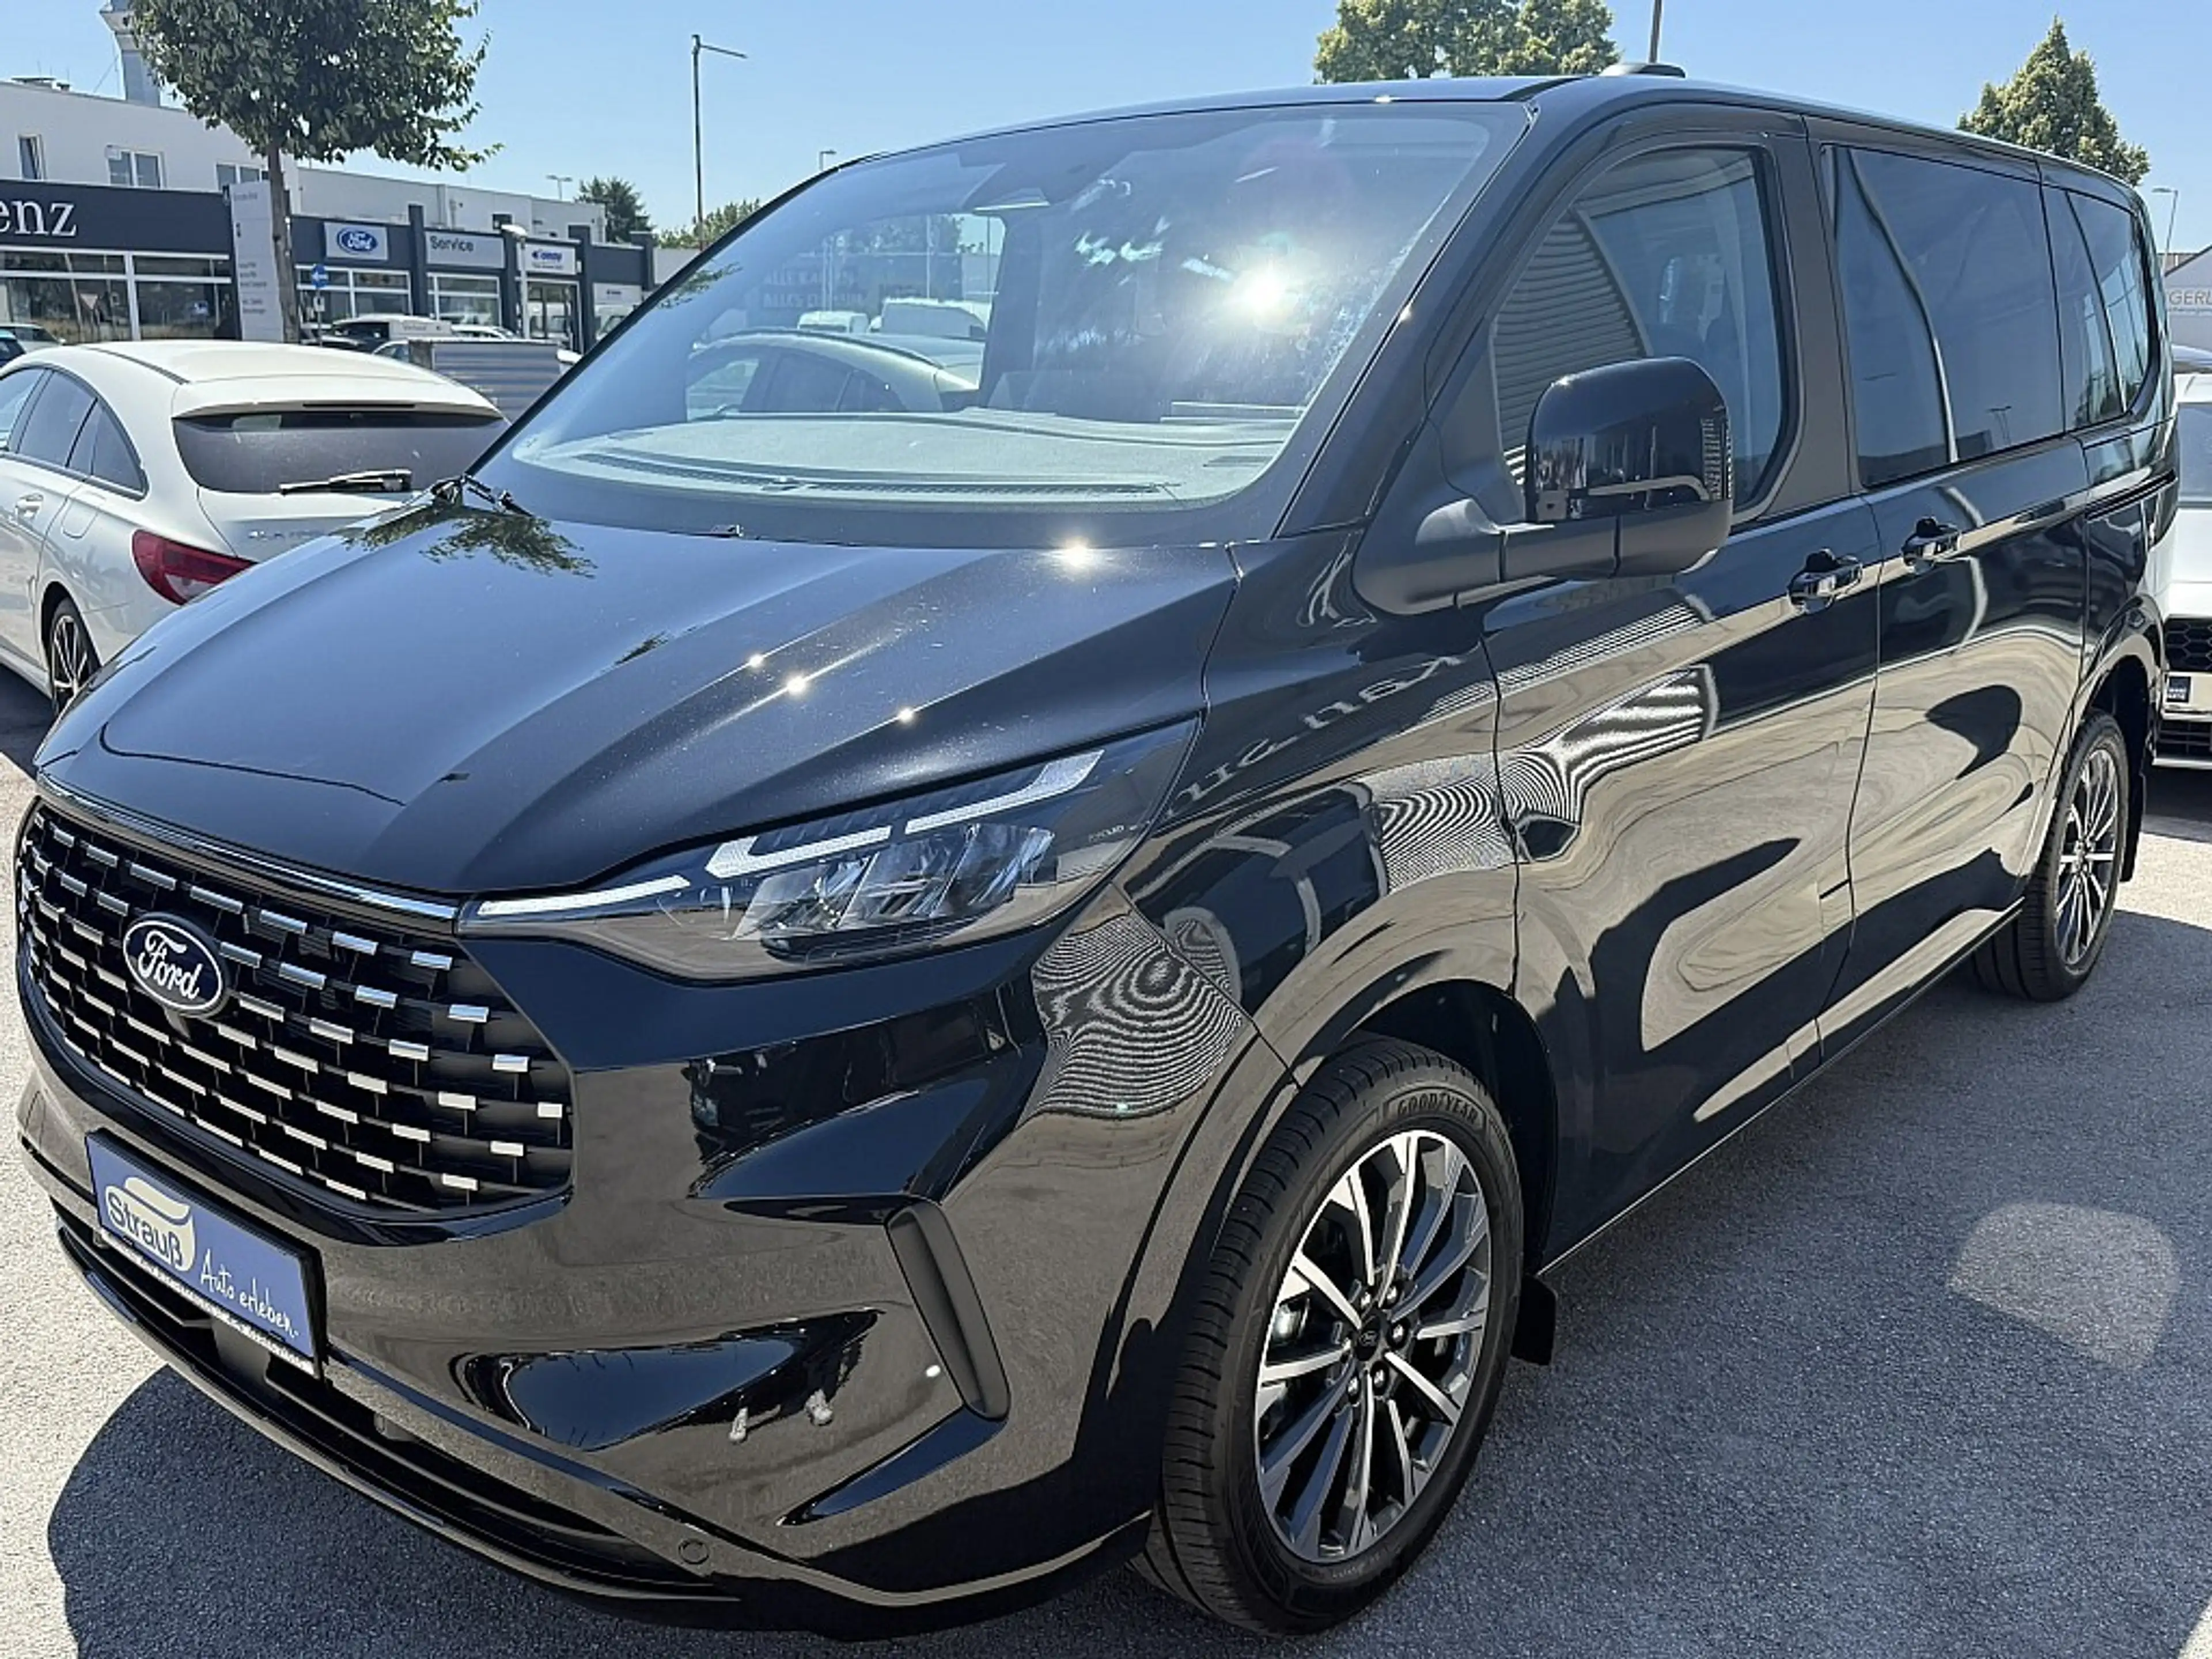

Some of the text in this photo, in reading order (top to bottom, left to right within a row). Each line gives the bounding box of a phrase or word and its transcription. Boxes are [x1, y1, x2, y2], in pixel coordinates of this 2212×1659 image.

[430, 236, 474, 252] Service
[138, 929, 203, 1000] Ford
[1398, 1093, 1479, 1124] GOODYEAR
[107, 1191, 183, 1267] Strauß
[200, 1248, 235, 1300] Auto
